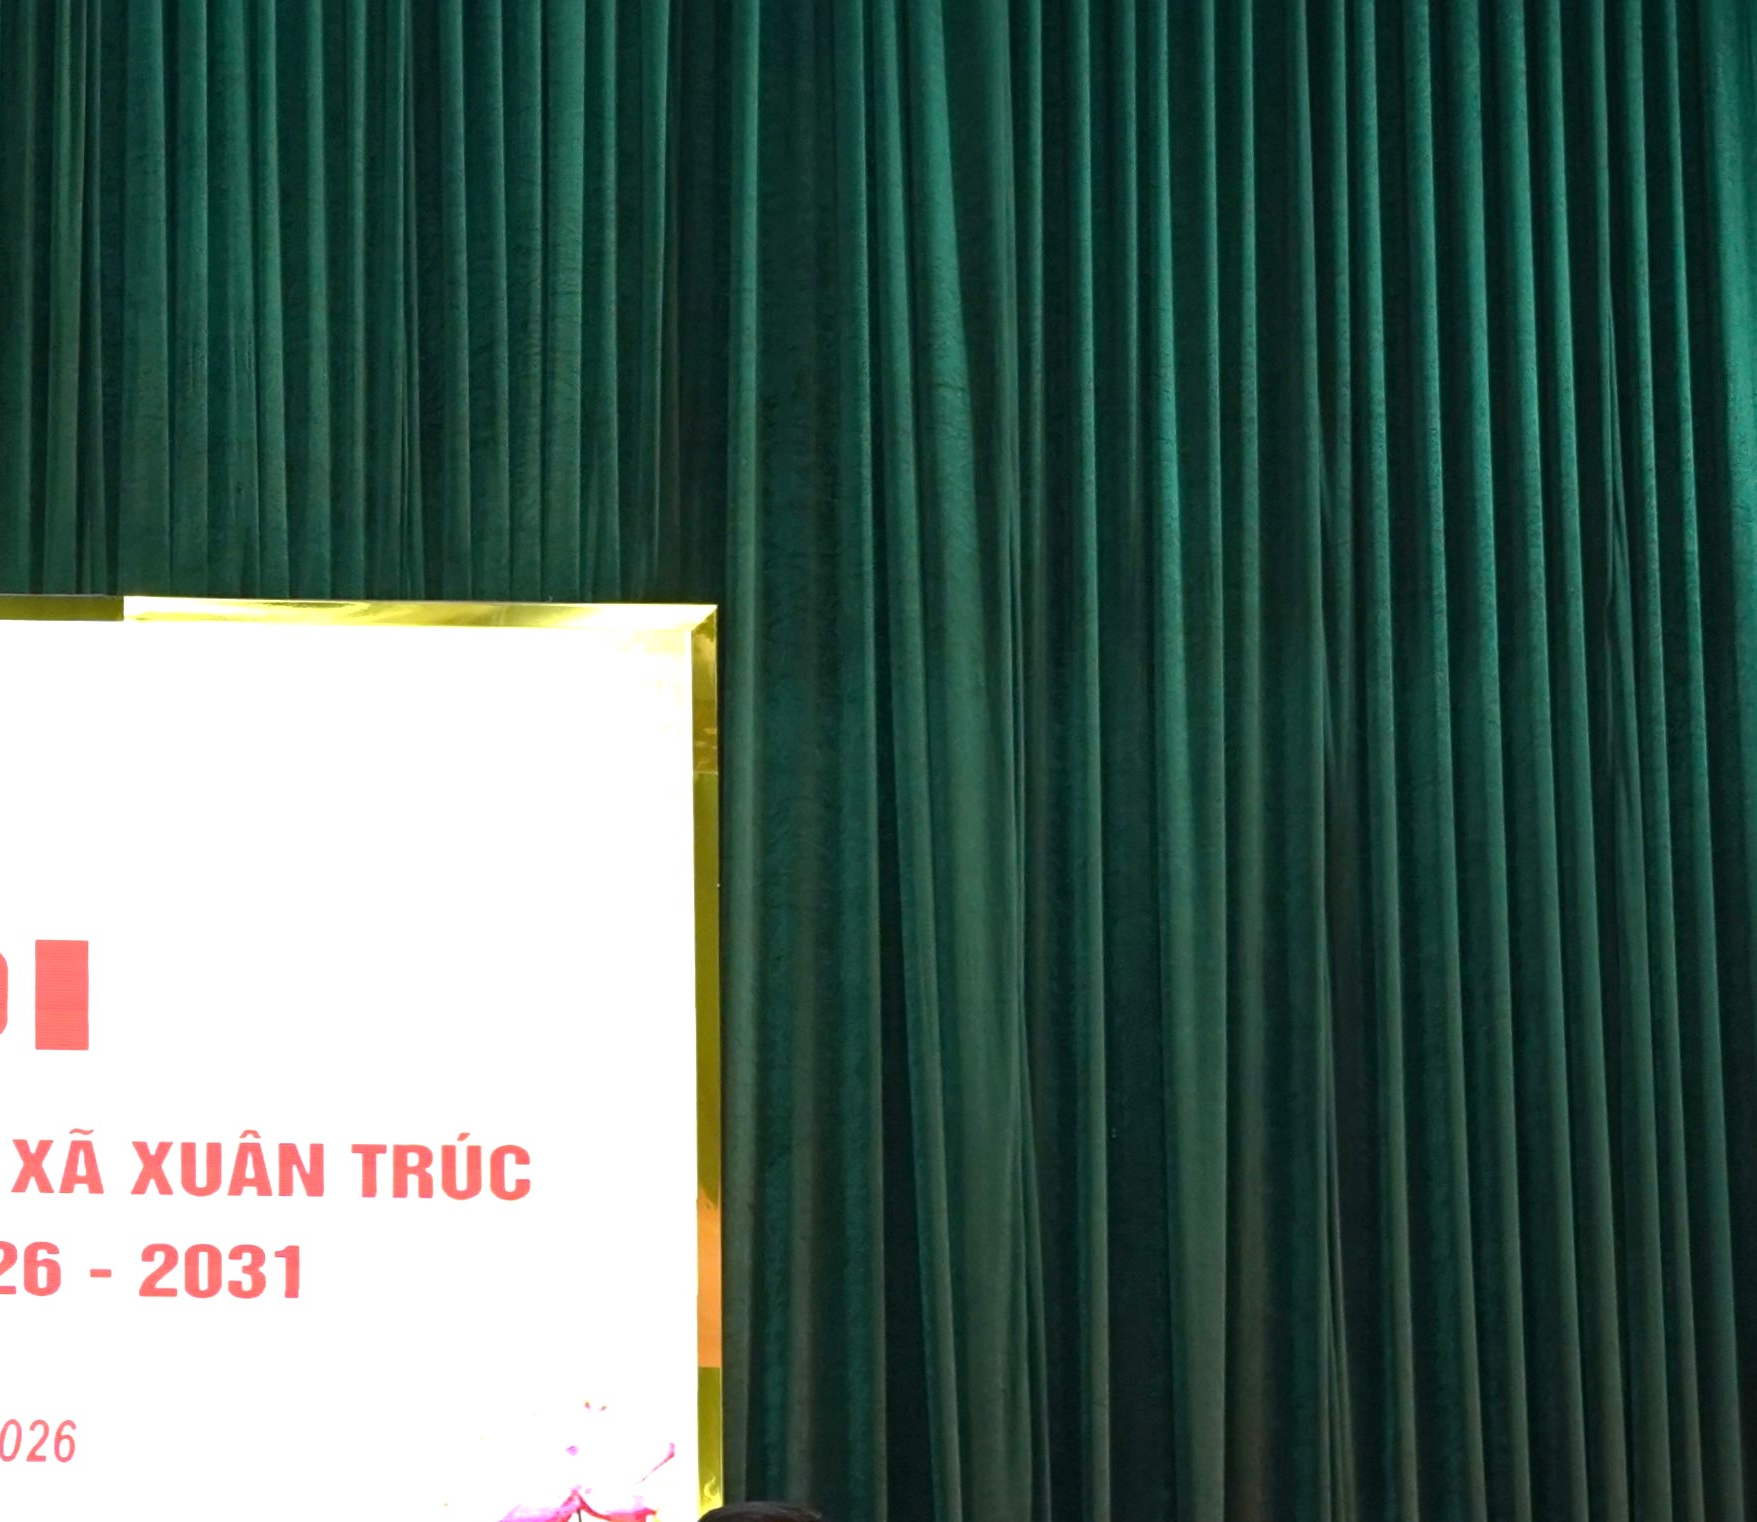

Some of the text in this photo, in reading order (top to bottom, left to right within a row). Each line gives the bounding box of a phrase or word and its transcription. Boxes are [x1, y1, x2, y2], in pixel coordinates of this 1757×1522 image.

[11, 1129, 104, 1194] XÃ
[131, 1130, 324, 1197] XUÂN
[352, 1133, 530, 1200] TRÚC
[90, 1269, 111, 1277] -
[139, 1244, 299, 1299] 2031
